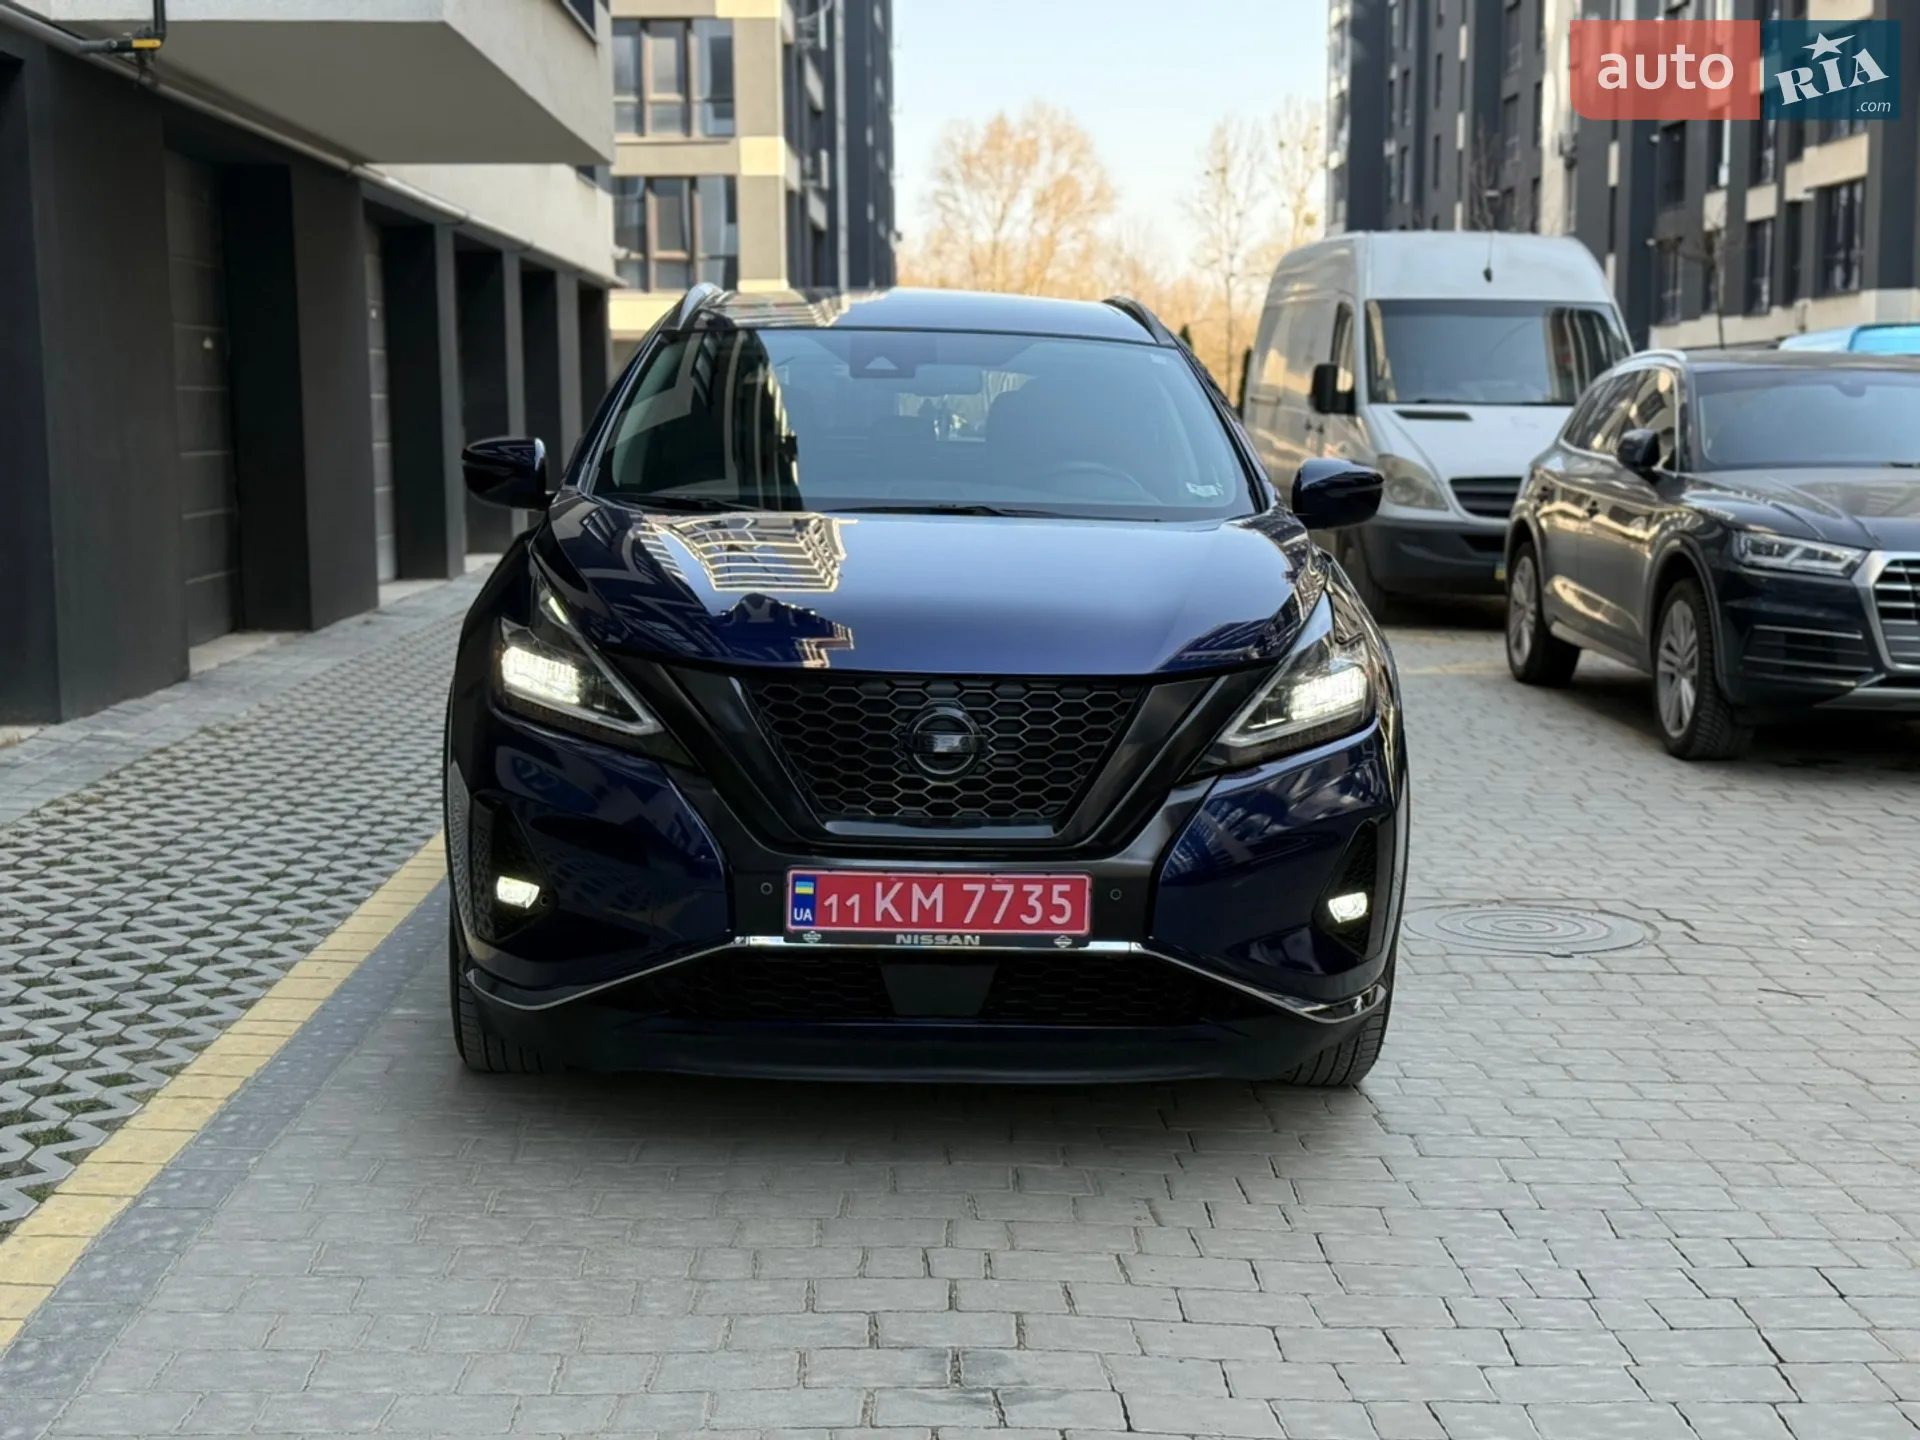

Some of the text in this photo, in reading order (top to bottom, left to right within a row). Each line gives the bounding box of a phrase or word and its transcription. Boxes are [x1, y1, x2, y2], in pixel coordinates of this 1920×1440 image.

[823, 882, 1072, 925] 11 KM 7735
[794, 908, 813, 922] UA
[896, 934, 980, 946] NISSAN
